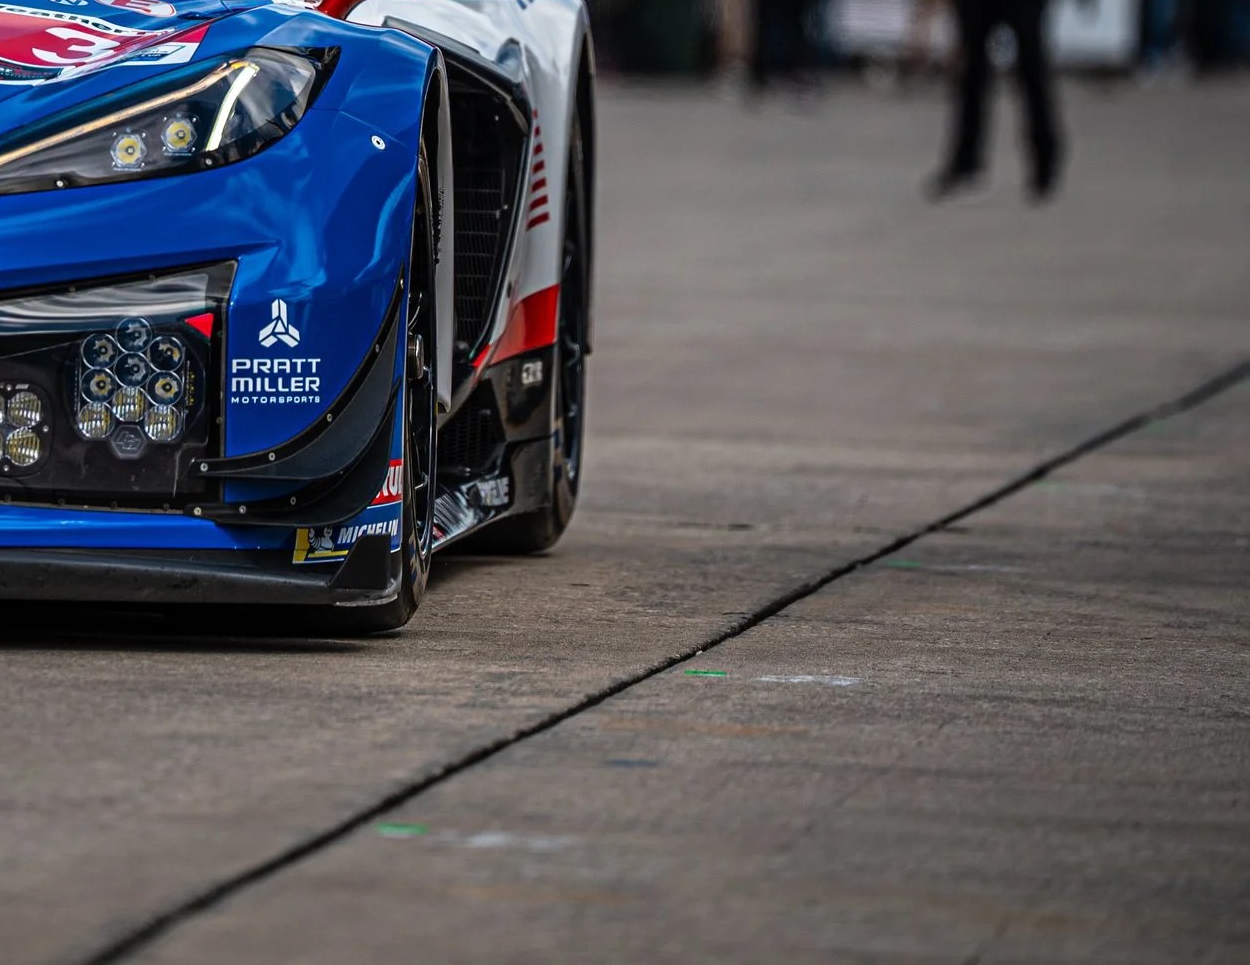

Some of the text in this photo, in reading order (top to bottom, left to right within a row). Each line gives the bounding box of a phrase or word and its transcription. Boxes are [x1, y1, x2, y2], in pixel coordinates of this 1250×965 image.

[31, 27, 121, 65] 3
[232, 358, 321, 374] PRATT
[231, 377, 320, 392] MILLER
[231, 396, 320, 404] MOTORSPORTS
[337, 518, 399, 545] MICHELIN
